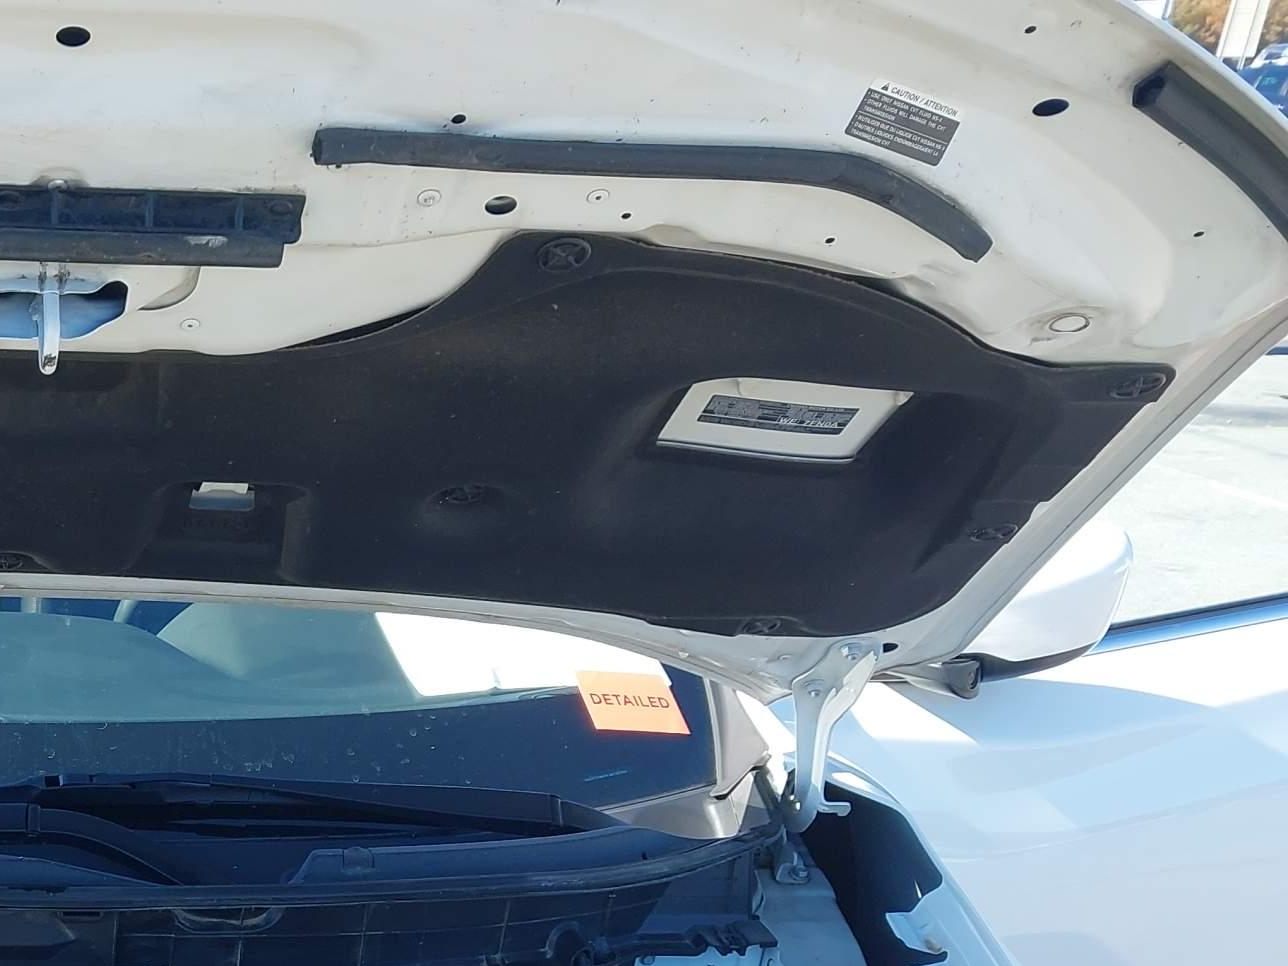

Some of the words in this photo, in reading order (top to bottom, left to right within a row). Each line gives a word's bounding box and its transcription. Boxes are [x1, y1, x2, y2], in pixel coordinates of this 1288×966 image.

[866, 98, 882, 108] OTHER
[881, 104, 899, 114] FLUIDS
[908, 113, 927, 124] DAMAGE
[890, 86, 921, 103] CAUTION
[924, 98, 959, 117] ATTENTION
[891, 99, 910, 110] NISSAN
[589, 692, 670, 709] DETAILED
